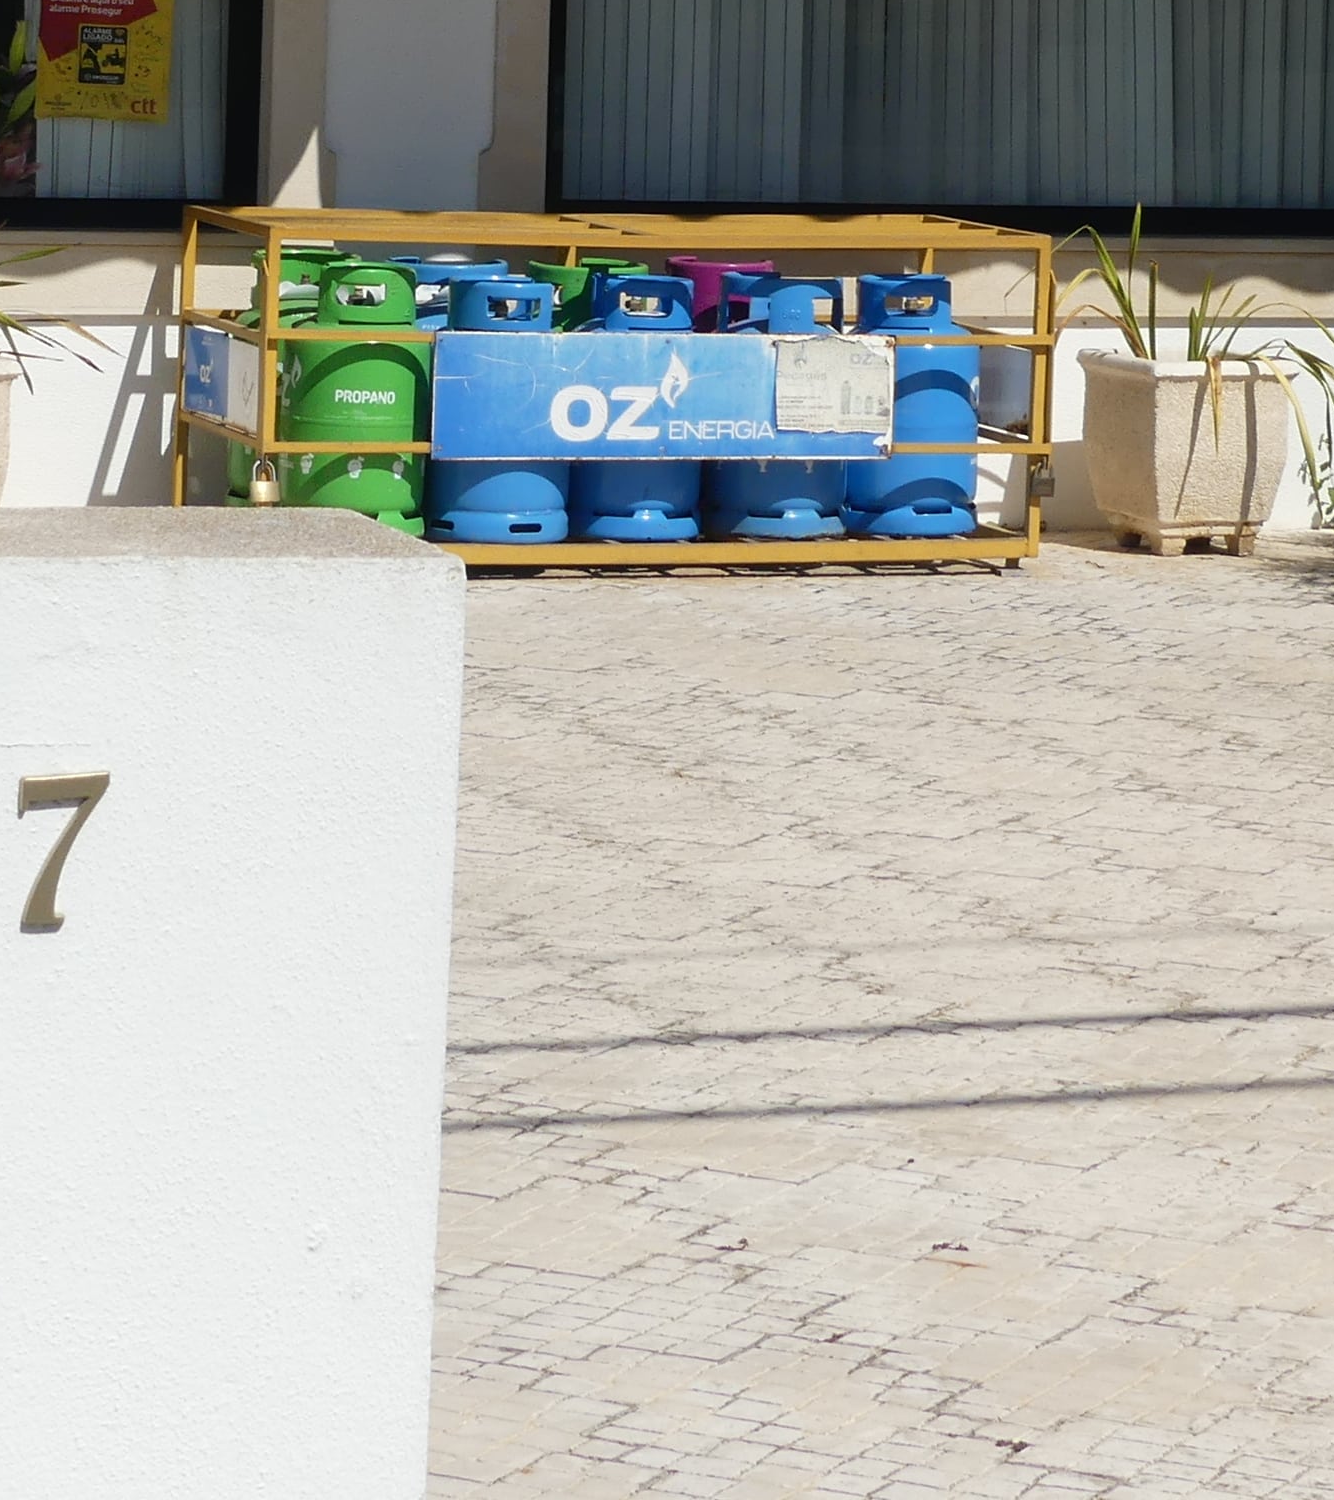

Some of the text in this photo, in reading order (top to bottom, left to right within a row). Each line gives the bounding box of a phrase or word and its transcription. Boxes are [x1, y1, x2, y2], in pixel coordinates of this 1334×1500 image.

[49, 3, 123, 17] alarme Prosegur
[130, 98, 158, 115] ctt
[334, 388, 397, 405] PROPANO
[550, 384, 776, 442] OZ ENERGIA
